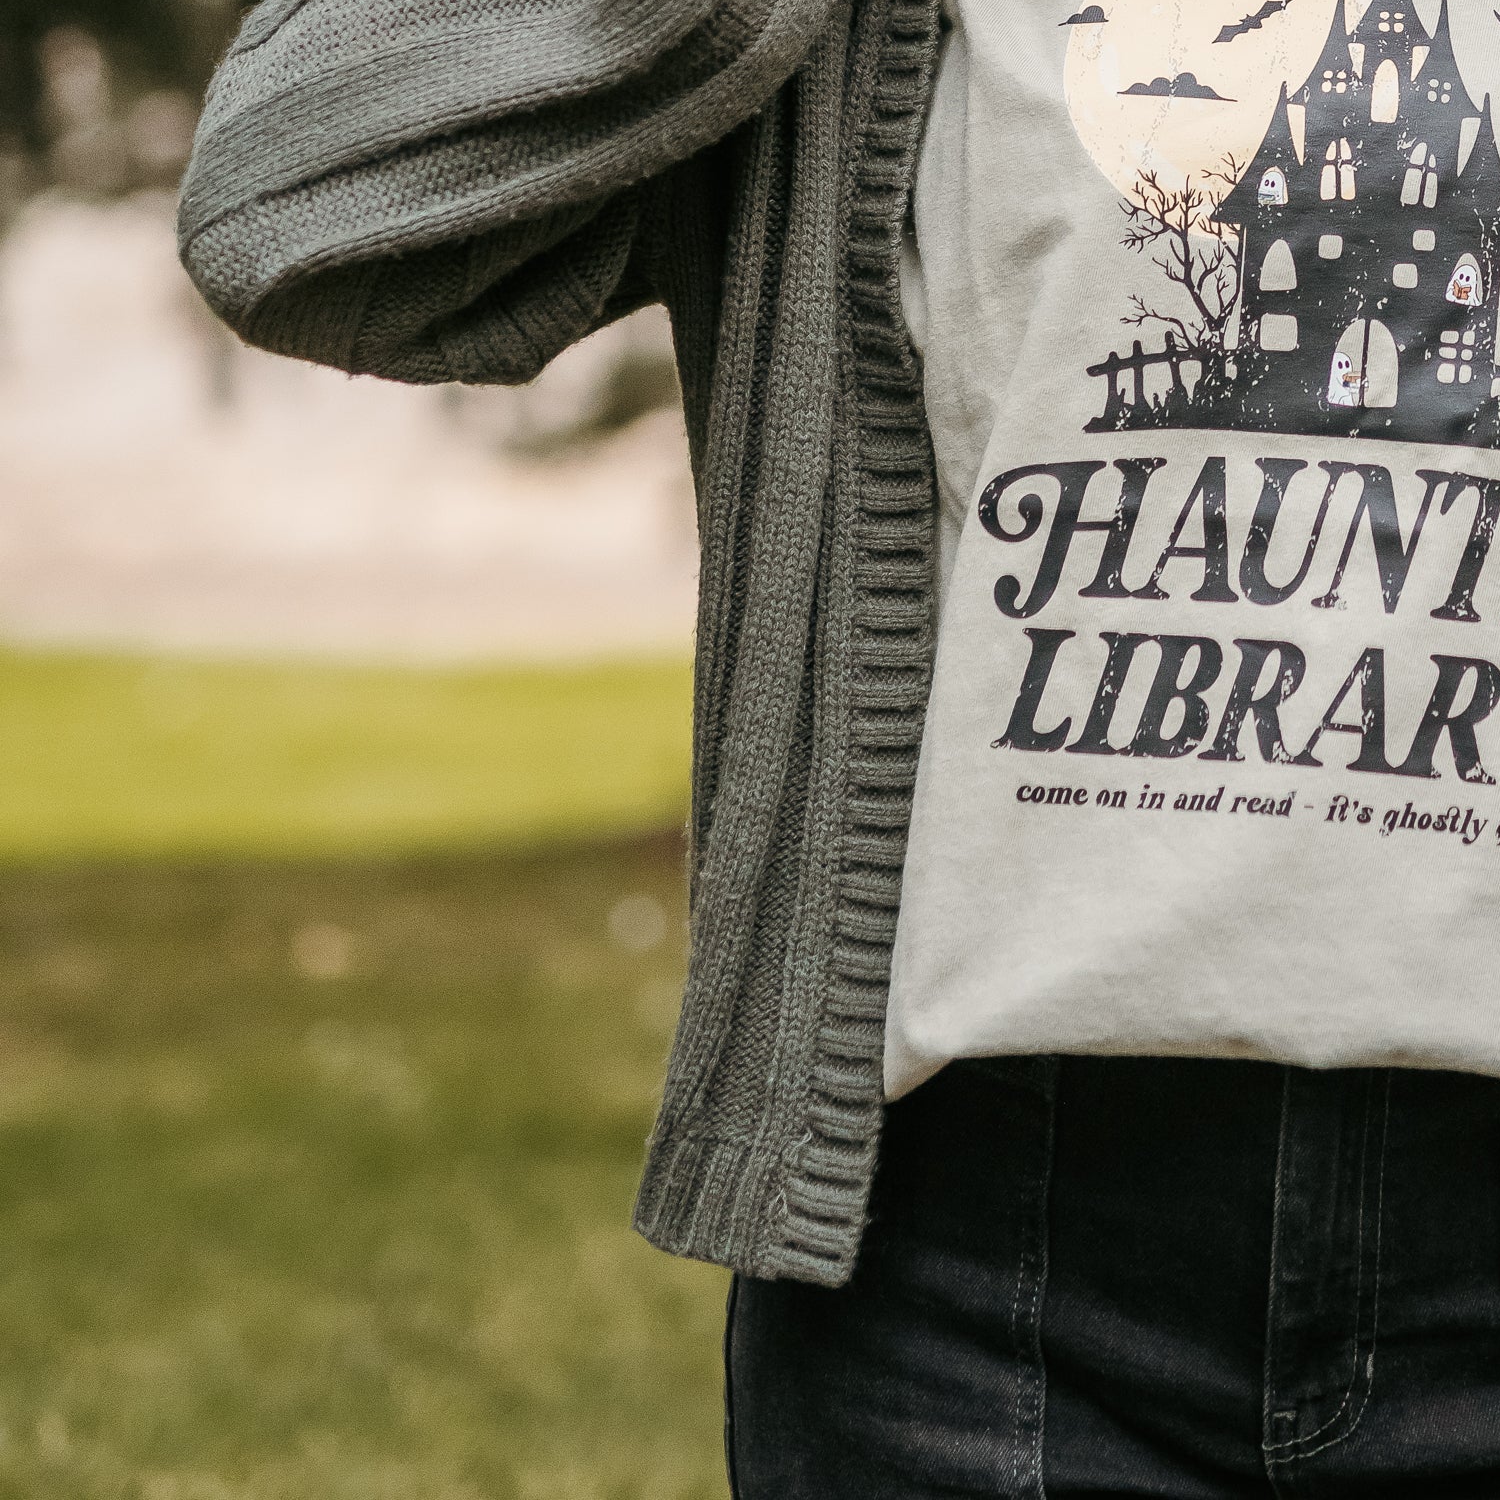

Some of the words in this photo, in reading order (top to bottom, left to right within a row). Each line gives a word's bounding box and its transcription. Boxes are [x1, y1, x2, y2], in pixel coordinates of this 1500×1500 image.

[1016, 785, 1089, 806] come
[1096, 789, 1128, 808] on
[1137, 784, 1166, 809] in
[1174, 786, 1225, 812] and
[1230, 791, 1297, 817] read
[1325, 795, 1374, 823] it's
[1380, 802, 1489, 844] ghostly
